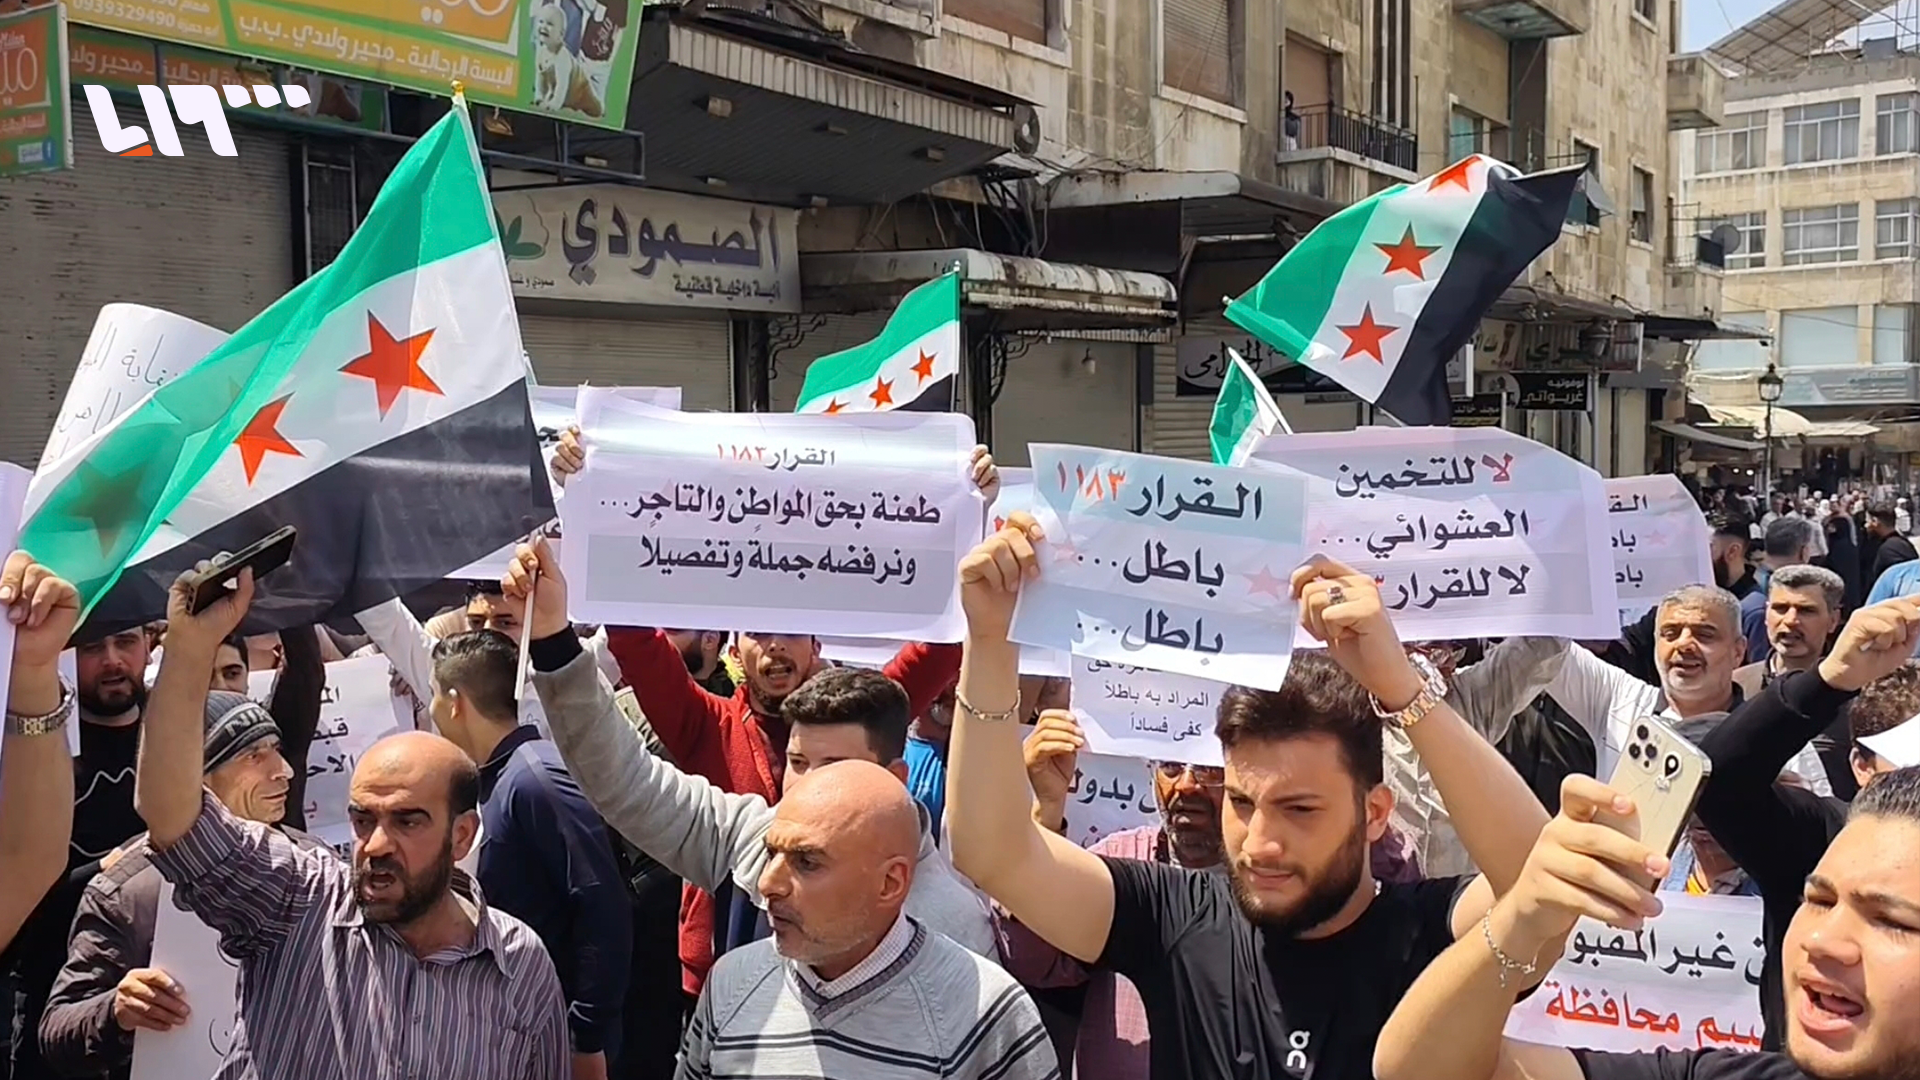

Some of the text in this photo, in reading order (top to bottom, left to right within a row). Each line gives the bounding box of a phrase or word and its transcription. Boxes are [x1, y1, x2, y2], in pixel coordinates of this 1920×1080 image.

[409, 45, 468, 80] الرجالية
[562, 198, 778, 286] الصمودي
[673, 273, 713, 299] قطنية
[714, 276, 752, 301] داخلية
[716, 443, 836, 471] القرار ١١٨٣
[1335, 453, 1514, 499] لا للتخمين
[728, 485, 812, 525] المواطن
[814, 490, 865, 530] بحق
[872, 491, 941, 525] طعنة
[1056, 459, 1262, 522] القرار ١١٨٣
[817, 544, 917, 586] ونرفضه
[1386, 563, 1532, 610] لا للقرار
[1144, 690, 1162, 707] به
[1167, 690, 1209, 708] المراد
[1173, 722, 1202, 741] كفى
[1567, 922, 1656, 967] المقبو
[1660, 931, 1737, 977] غير
[1544, 980, 1680, 1034] محافظة
